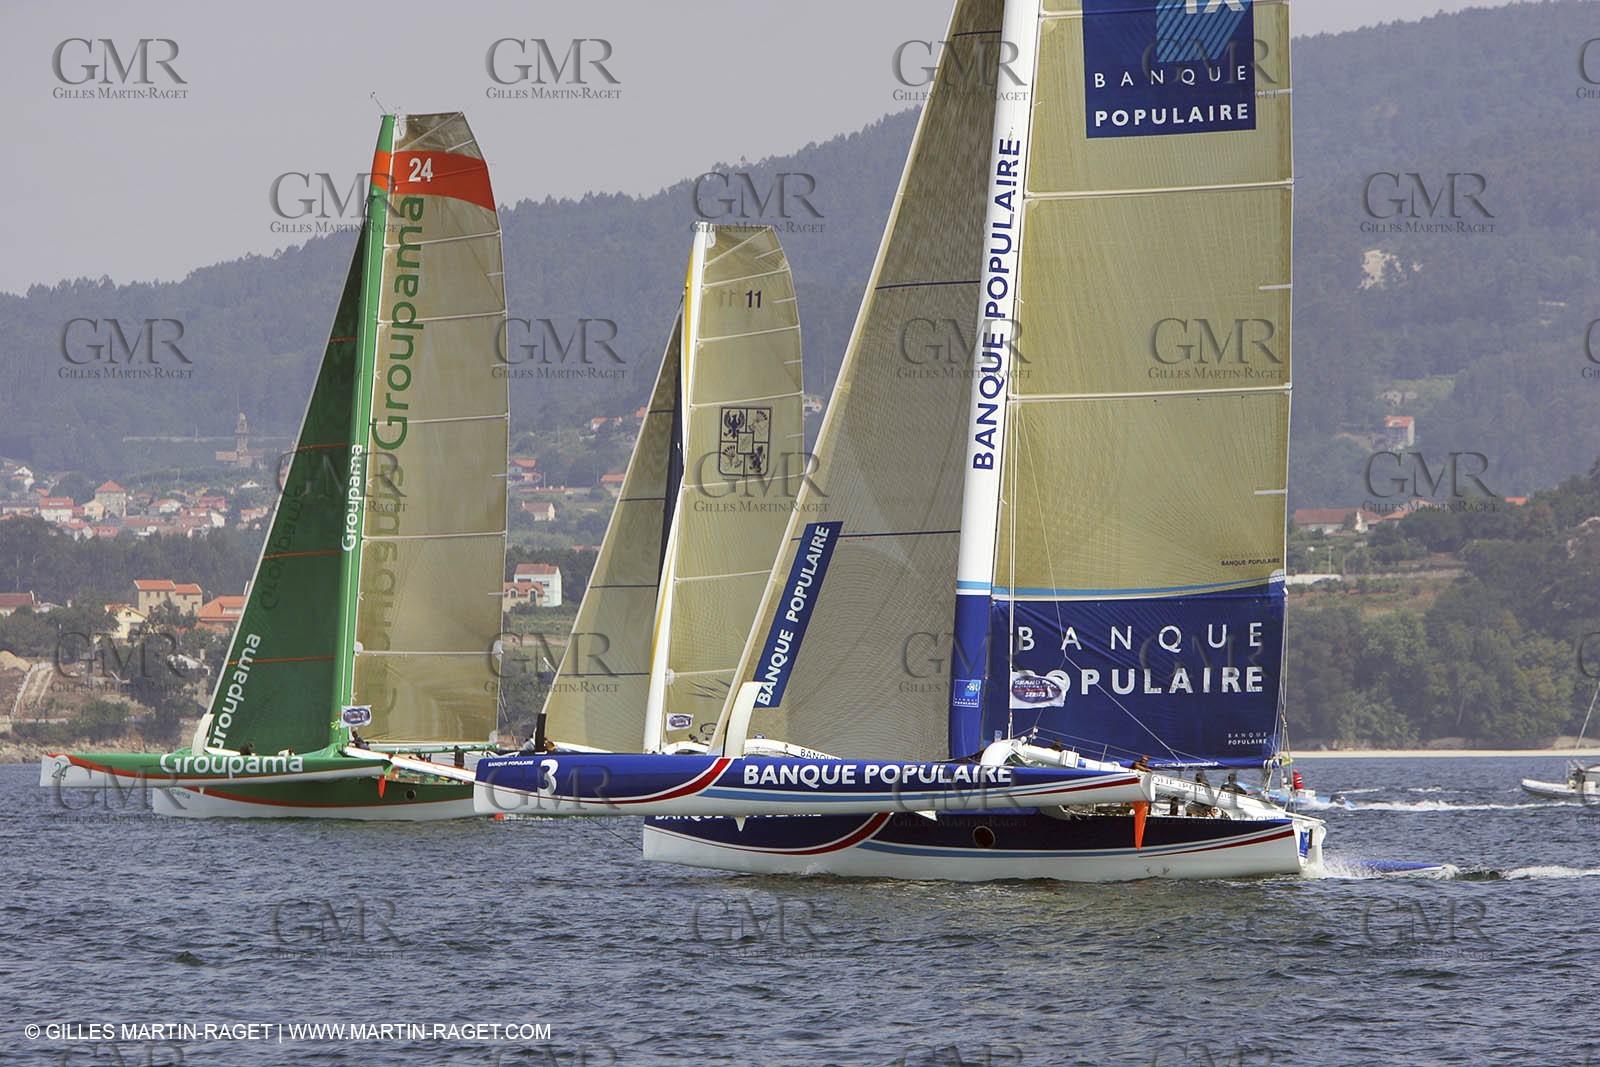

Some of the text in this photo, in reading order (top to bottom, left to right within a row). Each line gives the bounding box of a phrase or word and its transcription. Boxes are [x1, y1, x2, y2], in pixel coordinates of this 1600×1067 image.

[1094, 65, 1246, 88] BANQUE
[1095, 103, 1248, 127] POPULAIRE
[408, 157, 434, 182] 24
[745, 290, 762, 308] 11
[973, 138, 1020, 471] BANQUE POPULAIRE
[371, 197, 424, 451] Groupama
[342, 444, 363, 552] Groupama
[1248, 557, 1281, 565] POPULAIRE
[757, 525, 830, 706] BANQUE POPULAIRE
[1018, 621, 1262, 653] BANQUE
[1228, 738, 1268, 746] POPULAIRE
[51, 761, 68, 781] 24
[160, 754, 304, 779] Groupama
[539, 759, 558, 796] 3
[744, 763, 1013, 789] BANQUE POPULAIRE
